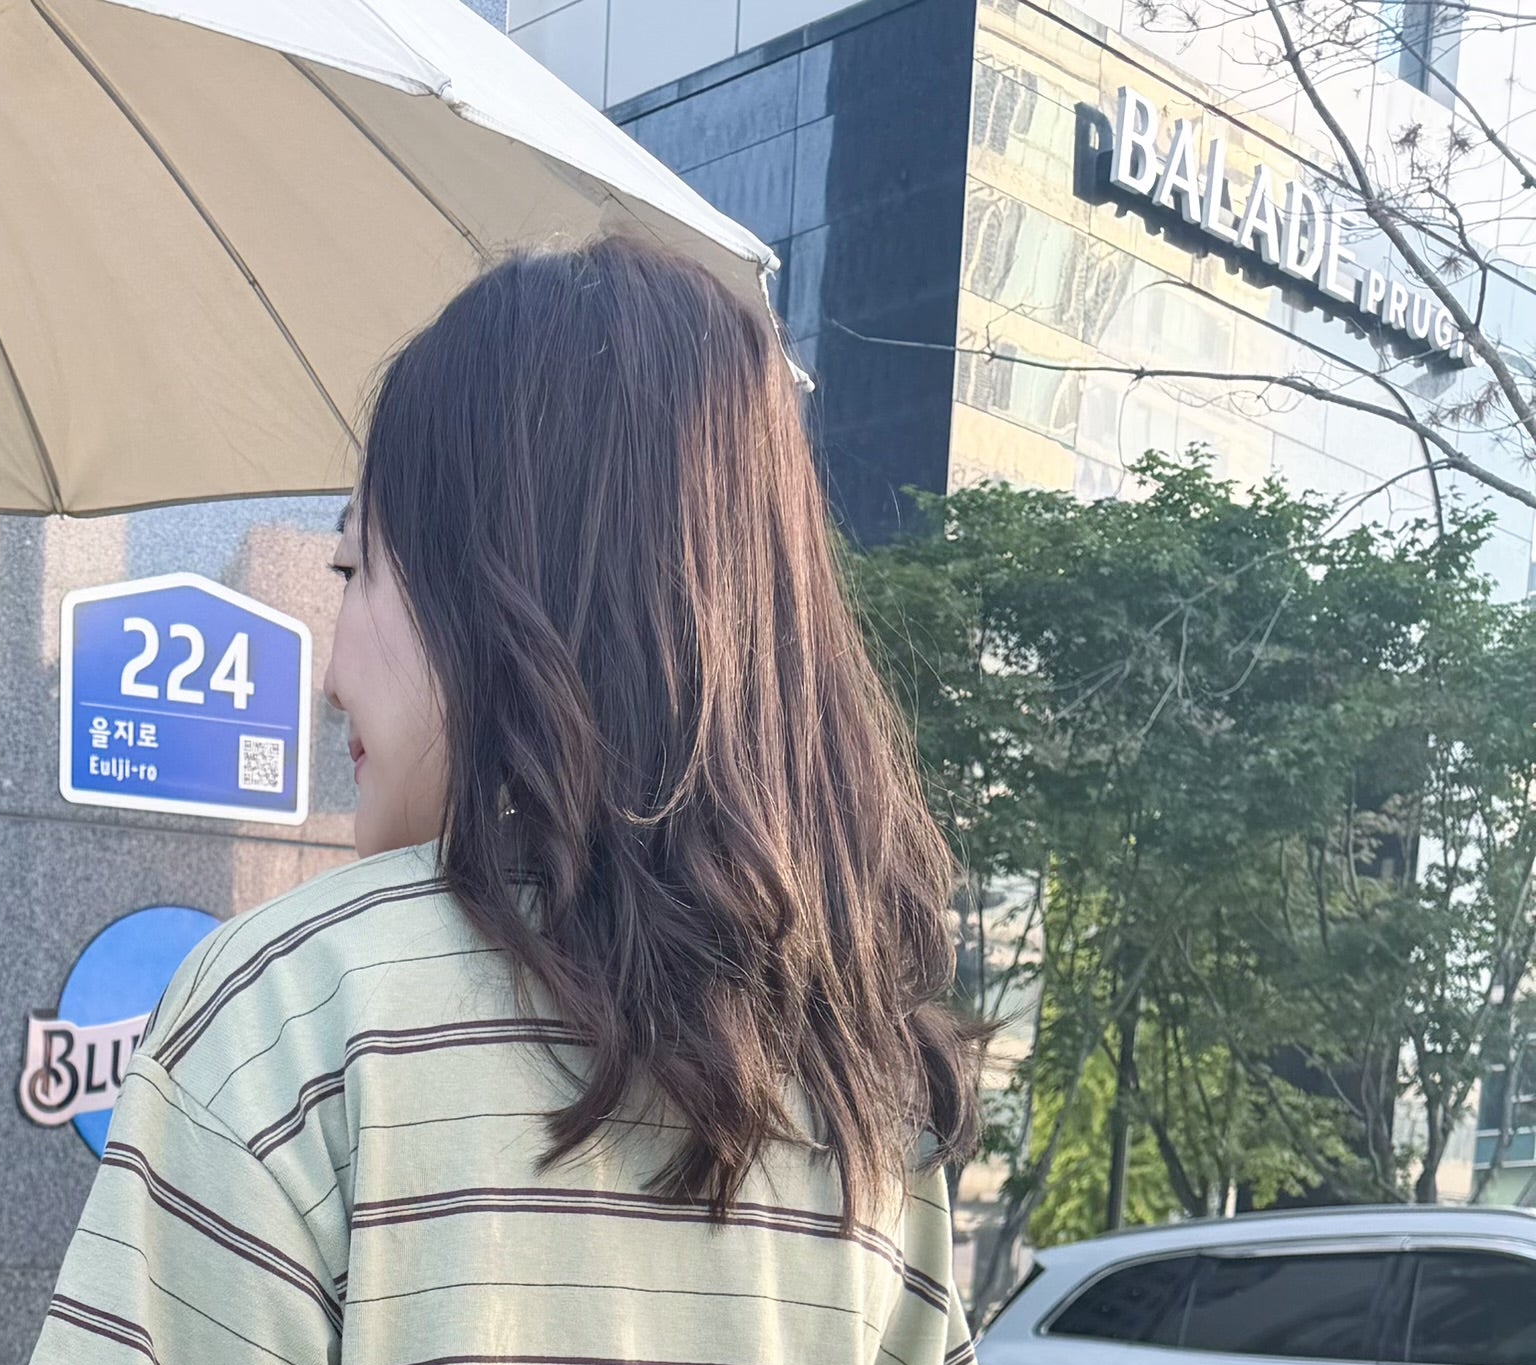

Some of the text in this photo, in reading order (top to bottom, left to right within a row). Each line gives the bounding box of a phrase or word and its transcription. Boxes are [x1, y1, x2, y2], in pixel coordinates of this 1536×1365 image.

[1111, 86, 1361, 303] BALADE
[120, 616, 255, 710] 224
[88, 716, 159, 750] 을지로
[89, 755, 158, 782] Eulji-ro
